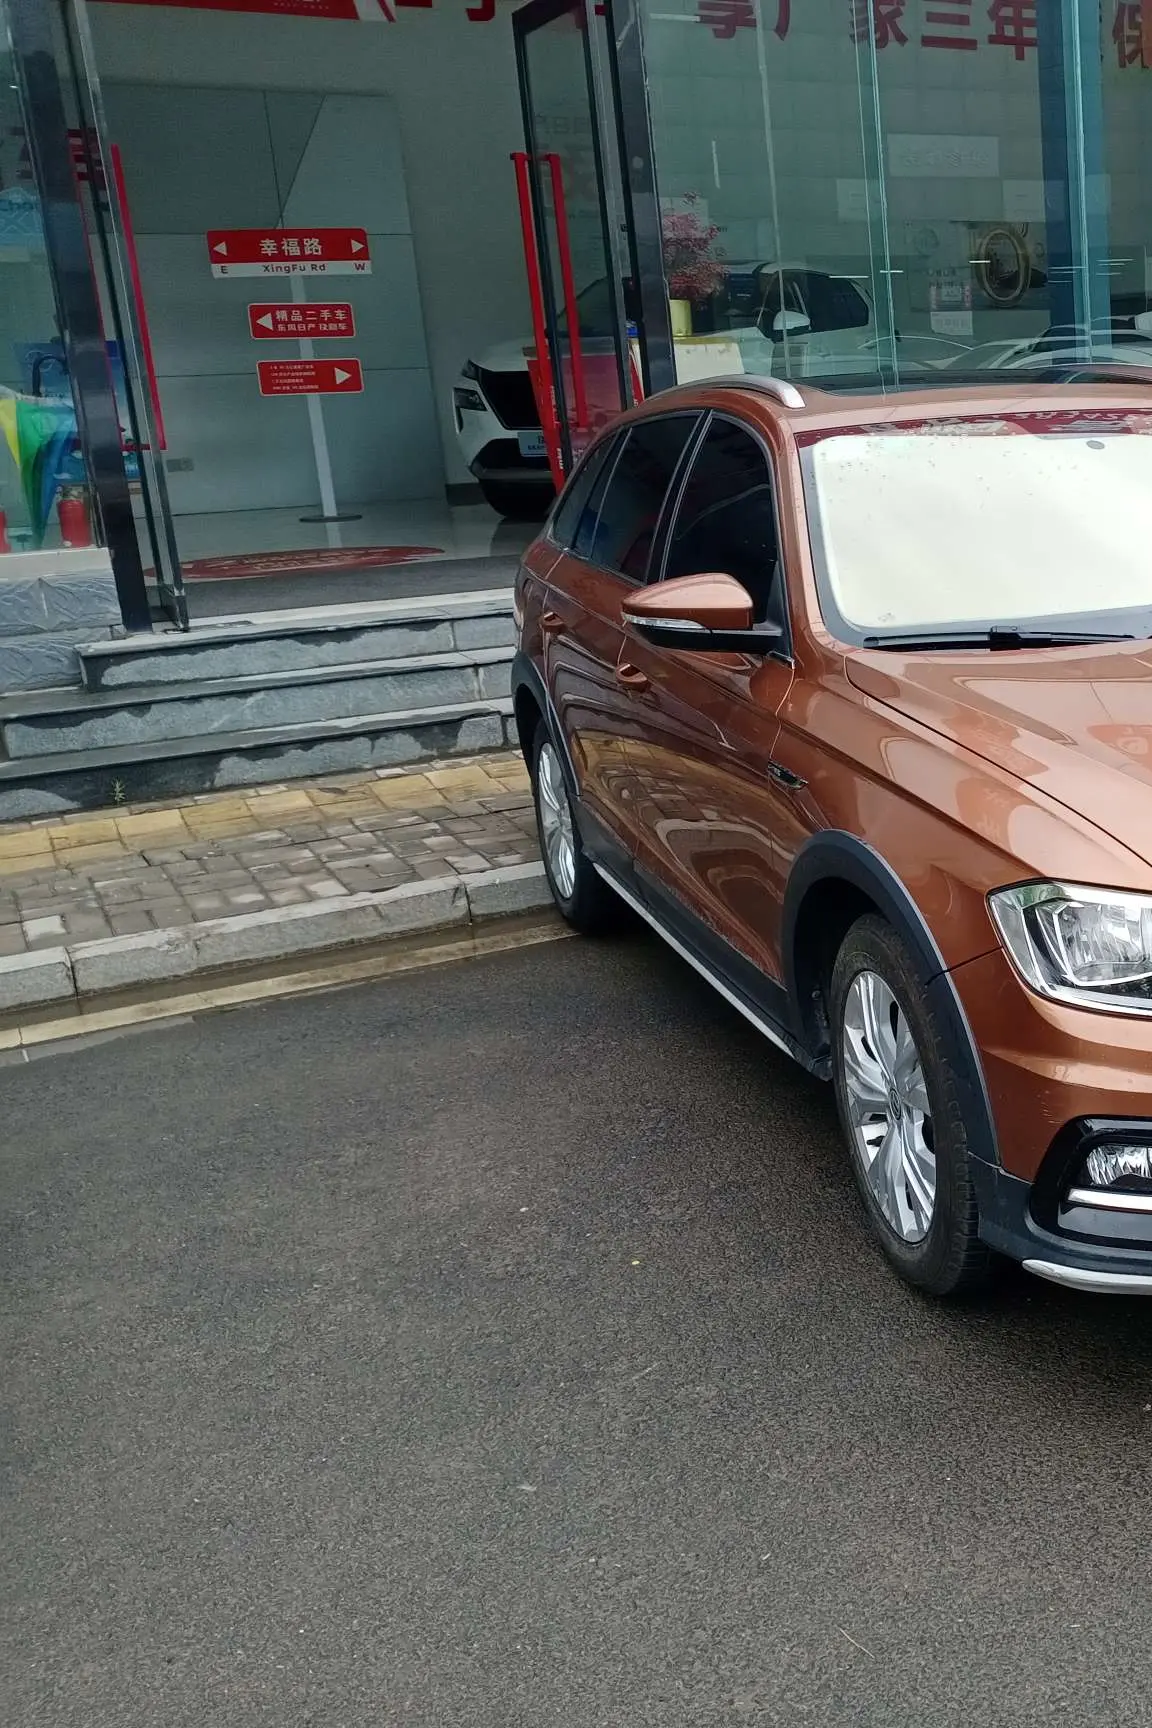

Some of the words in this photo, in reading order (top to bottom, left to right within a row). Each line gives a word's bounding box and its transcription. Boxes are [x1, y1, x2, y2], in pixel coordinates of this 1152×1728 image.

[259, 237, 322, 256] 幸福路
[220, 265, 229, 274] E
[263, 263, 306, 274] XingFu
[311, 263, 326, 272] Rd
[354, 262, 366, 271] W
[275, 309, 348, 322] 精品二手车
